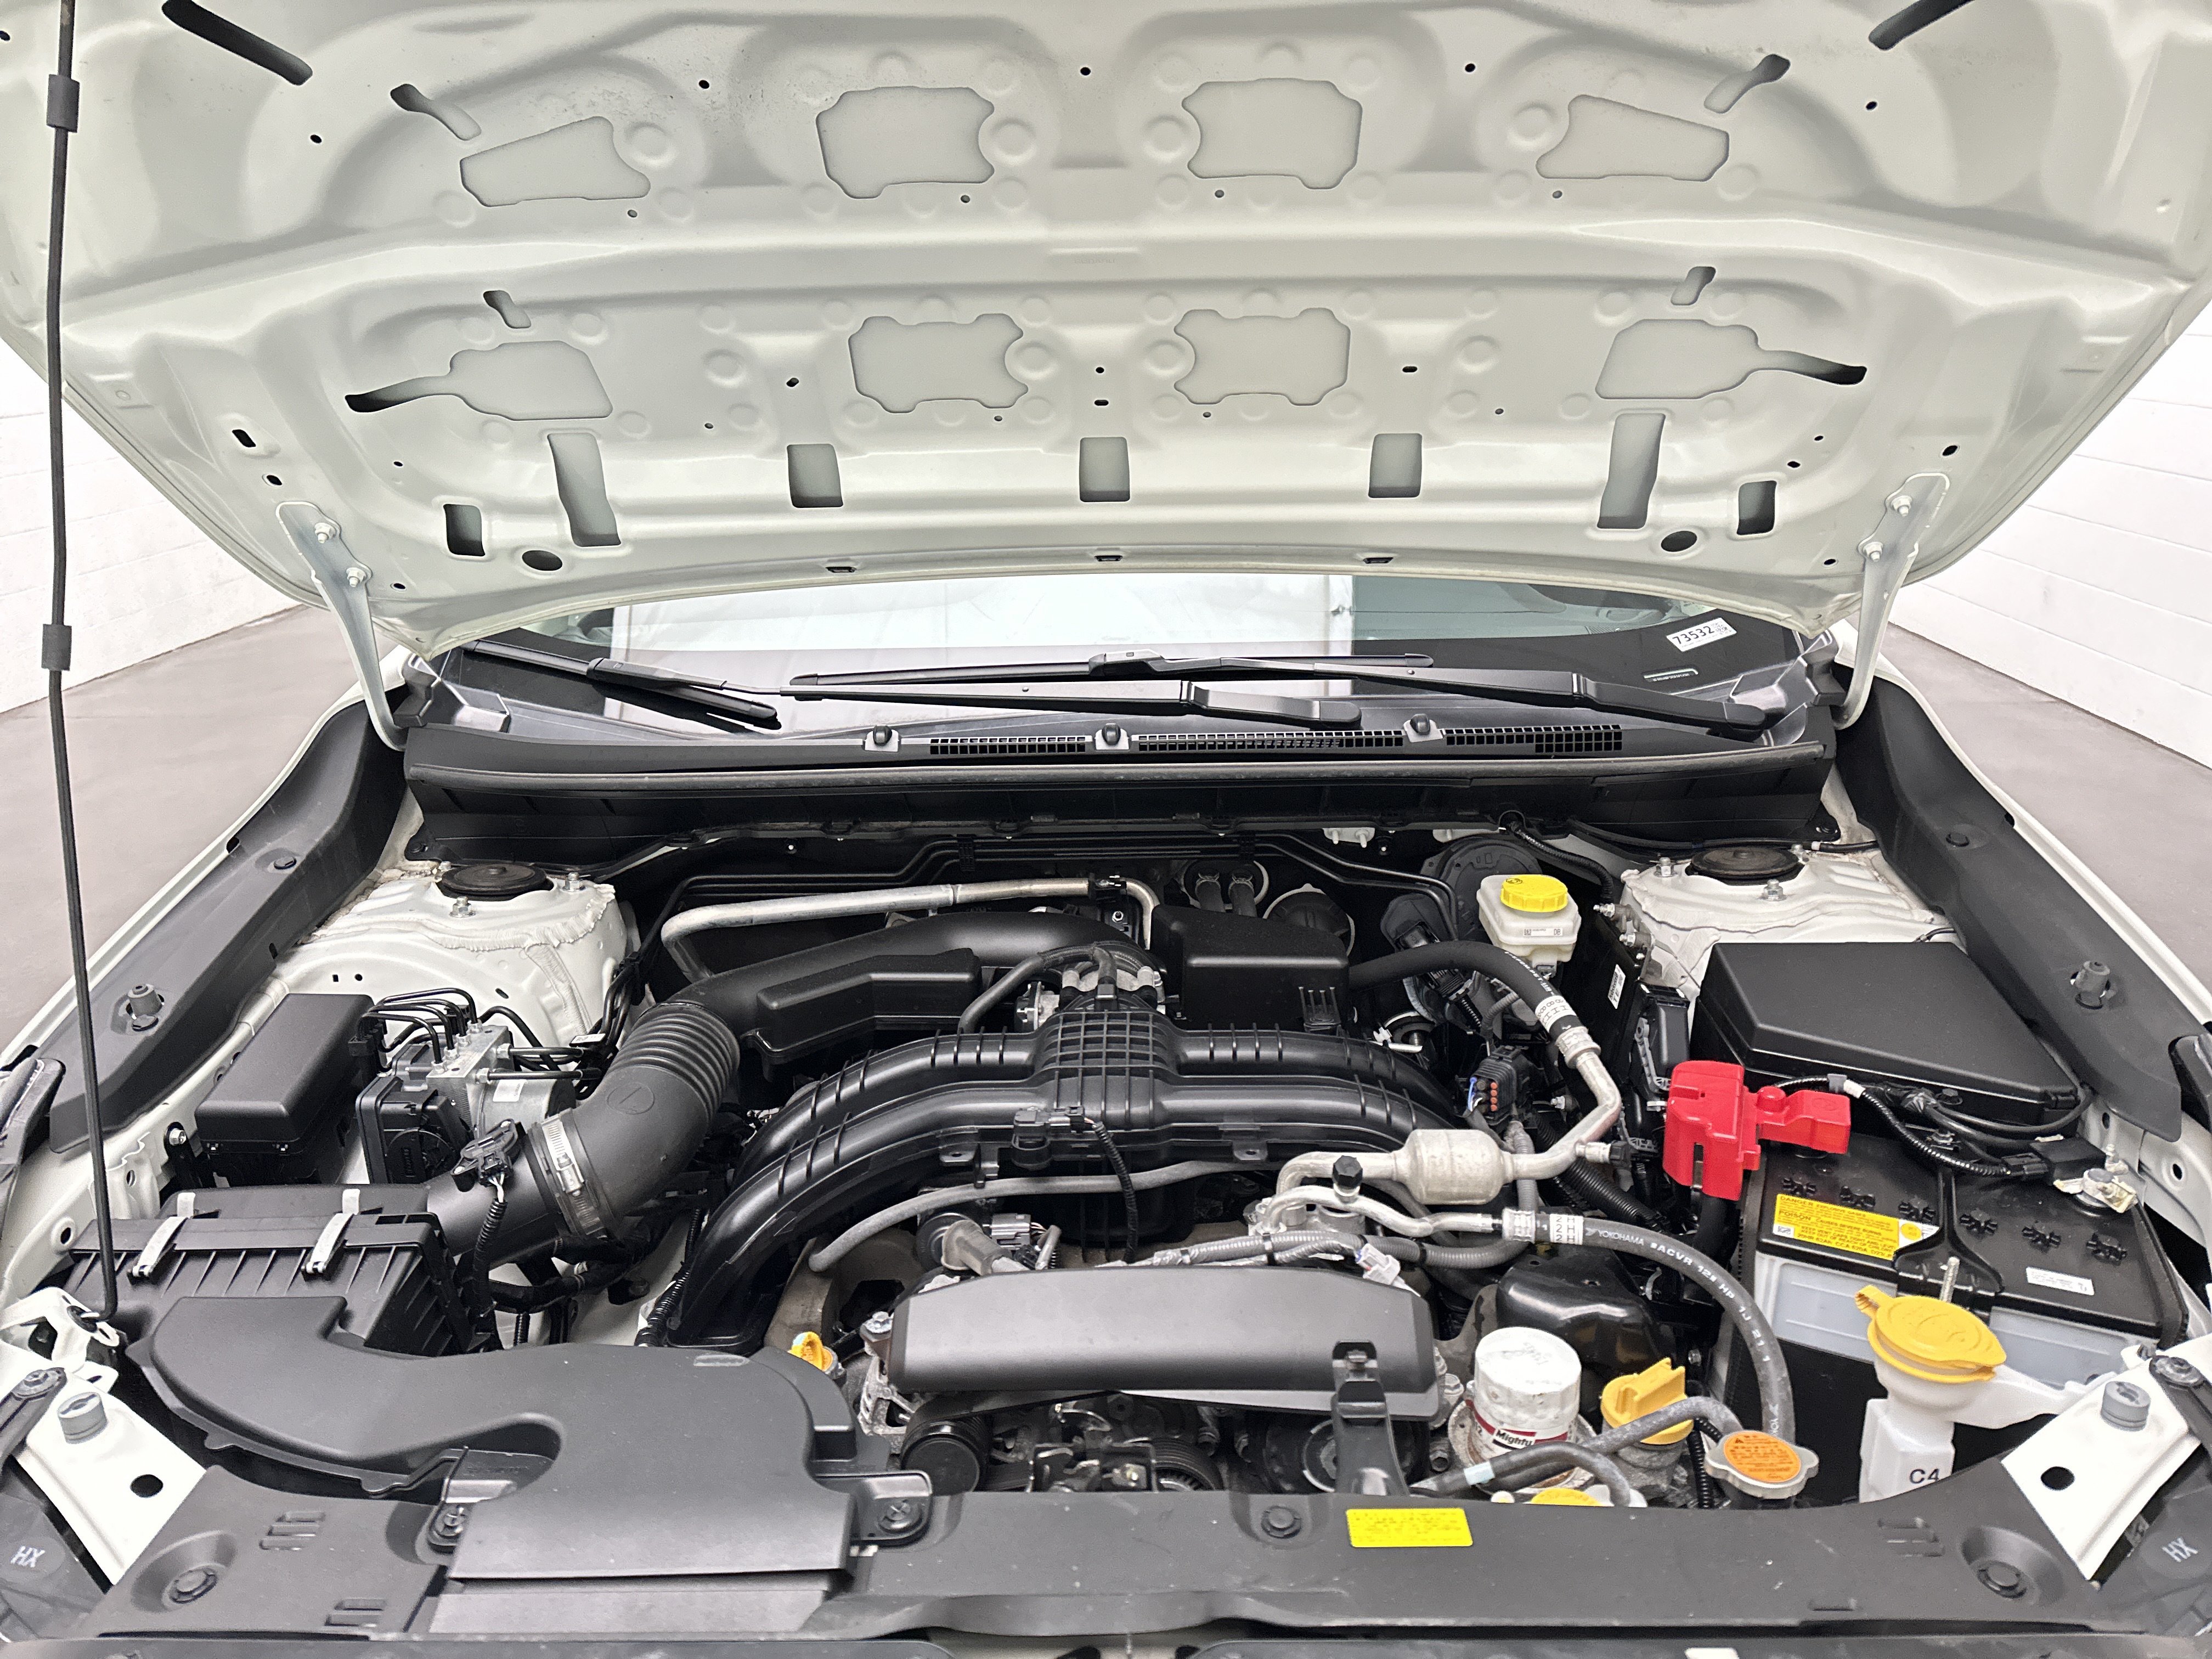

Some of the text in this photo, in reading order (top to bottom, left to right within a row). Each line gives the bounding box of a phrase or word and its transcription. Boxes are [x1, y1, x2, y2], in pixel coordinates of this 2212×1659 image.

[1672, 625, 1715, 645] 73532
[1780, 1195, 1814, 1207] DANGER
[1779, 1210, 1811, 1221] POISON
[1556, 1224, 1562, 1233] 2
[1567, 1225, 1575, 1233] H
[1597, 1229, 1645, 1246] YOKOHAMA
[1910, 1468, 1940, 1484] C4
[10, 1545, 46, 1568] HX
[2162, 1537, 2199, 1563] HX
